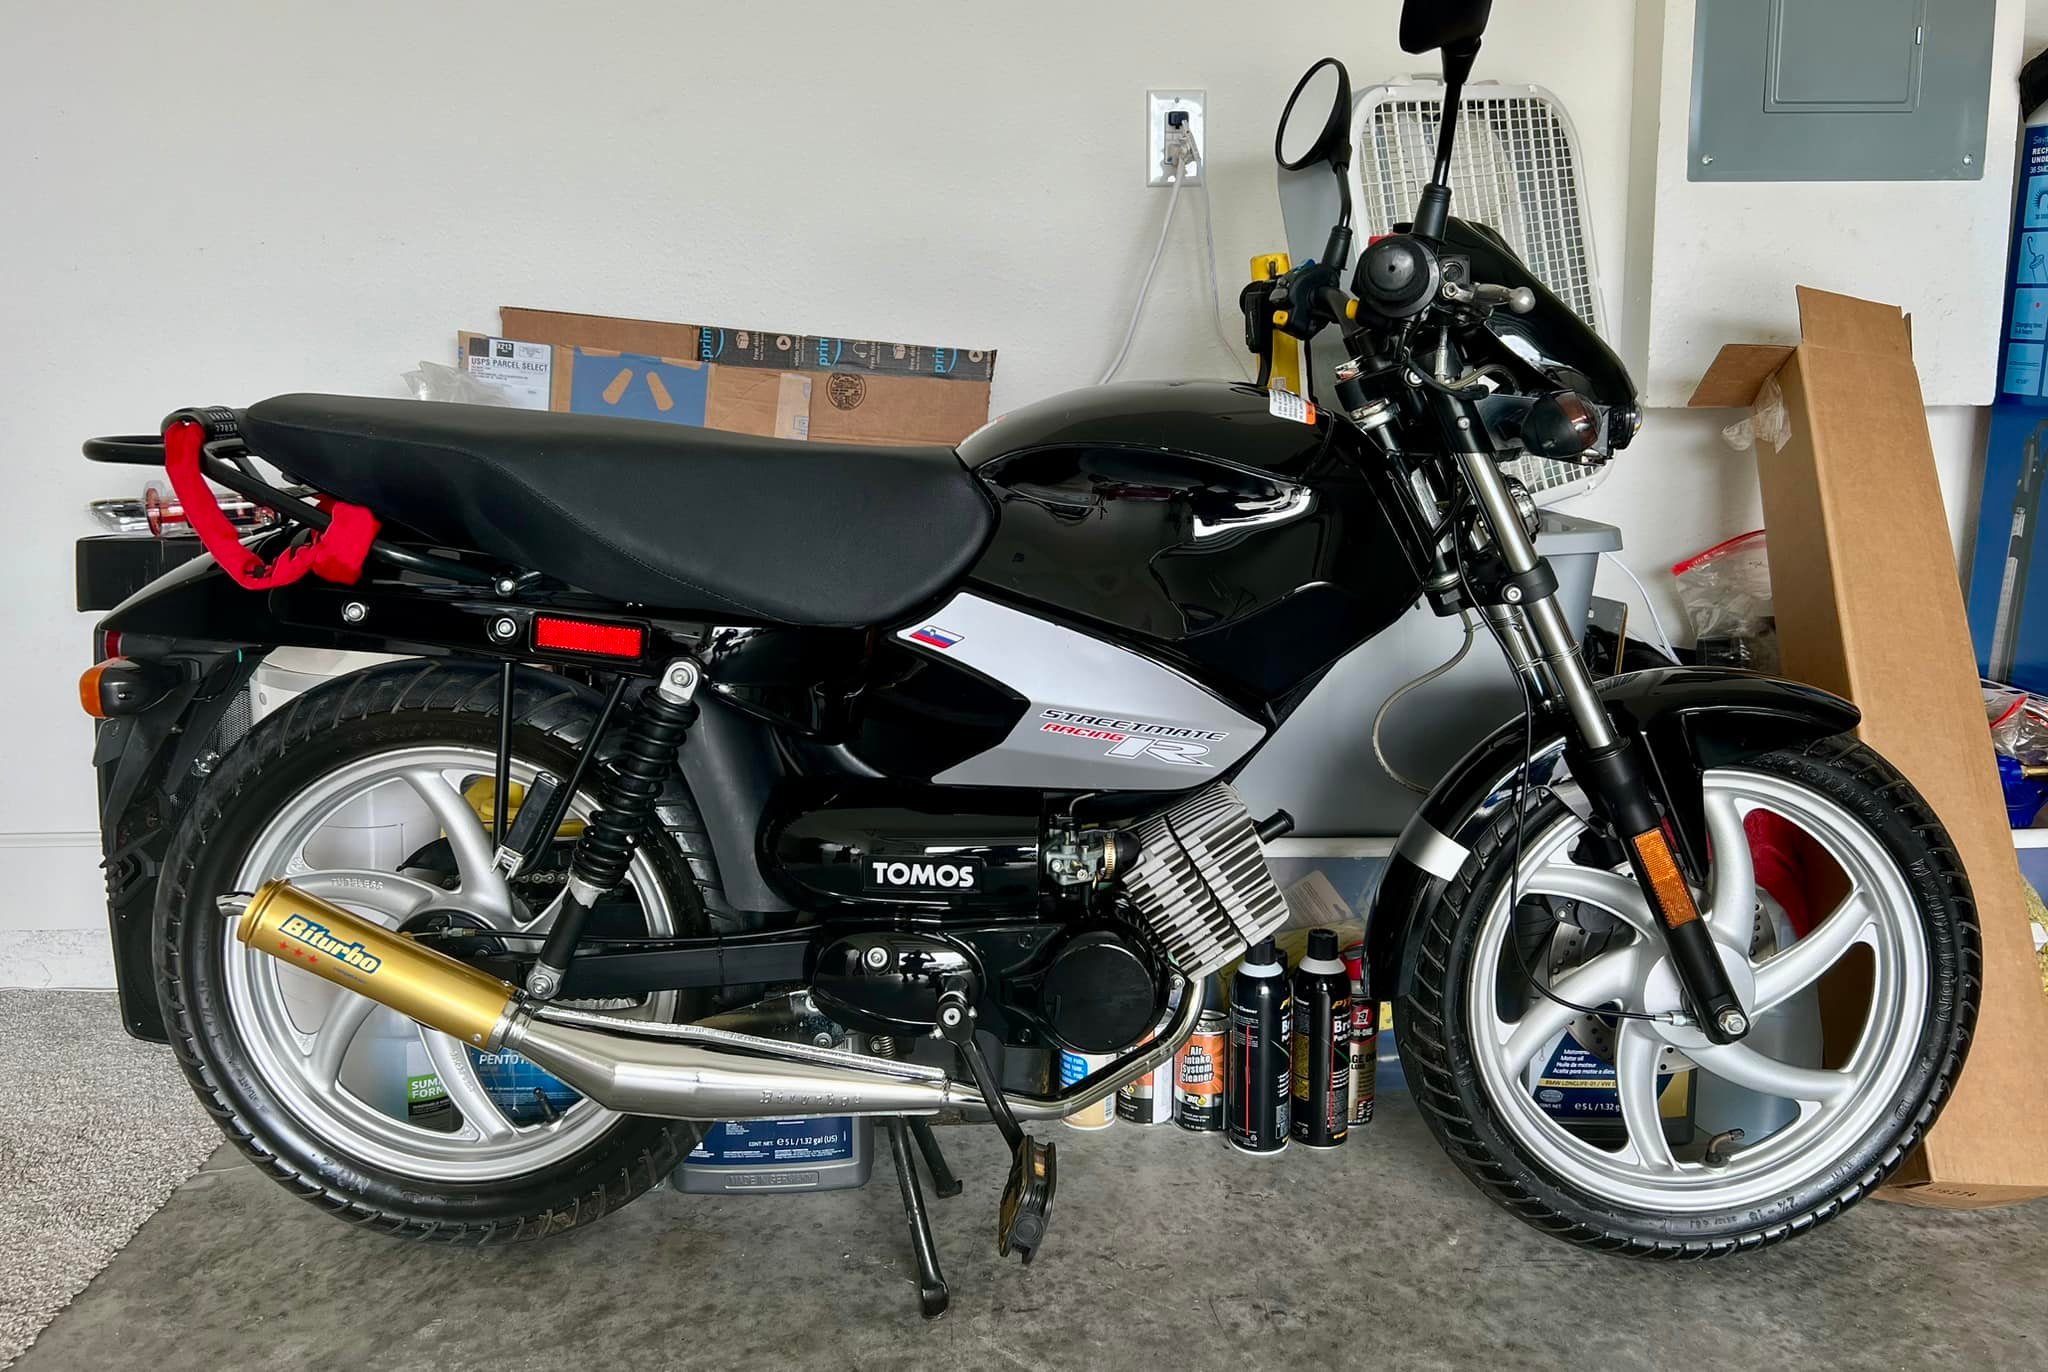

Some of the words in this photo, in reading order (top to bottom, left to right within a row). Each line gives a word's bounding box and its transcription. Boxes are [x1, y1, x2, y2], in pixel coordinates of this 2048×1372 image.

[471, 357, 490, 366] USPS
[492, 359, 520, 369] PARCEL
[522, 361, 548, 373] SELECT
[1040, 709, 1230, 741] STREETMATE
[1040, 722, 1126, 743] RACING
[872, 862, 975, 888] TOMOS
[281, 916, 380, 973] Biturbo
[1190, 1046, 1203, 1055] Air
[479, 1054, 529, 1065] PENTO
[1184, 1055, 1211, 1064] Intake
[1182, 1064, 1213, 1073] System
[411, 1077, 441, 1091] SUM
[1182, 1073, 1214, 1083] Cleaner
[800, 1136, 813, 1145] 1.32
[813, 1135, 824, 1146] gal
[824, 1134, 838, 1144] (US)
